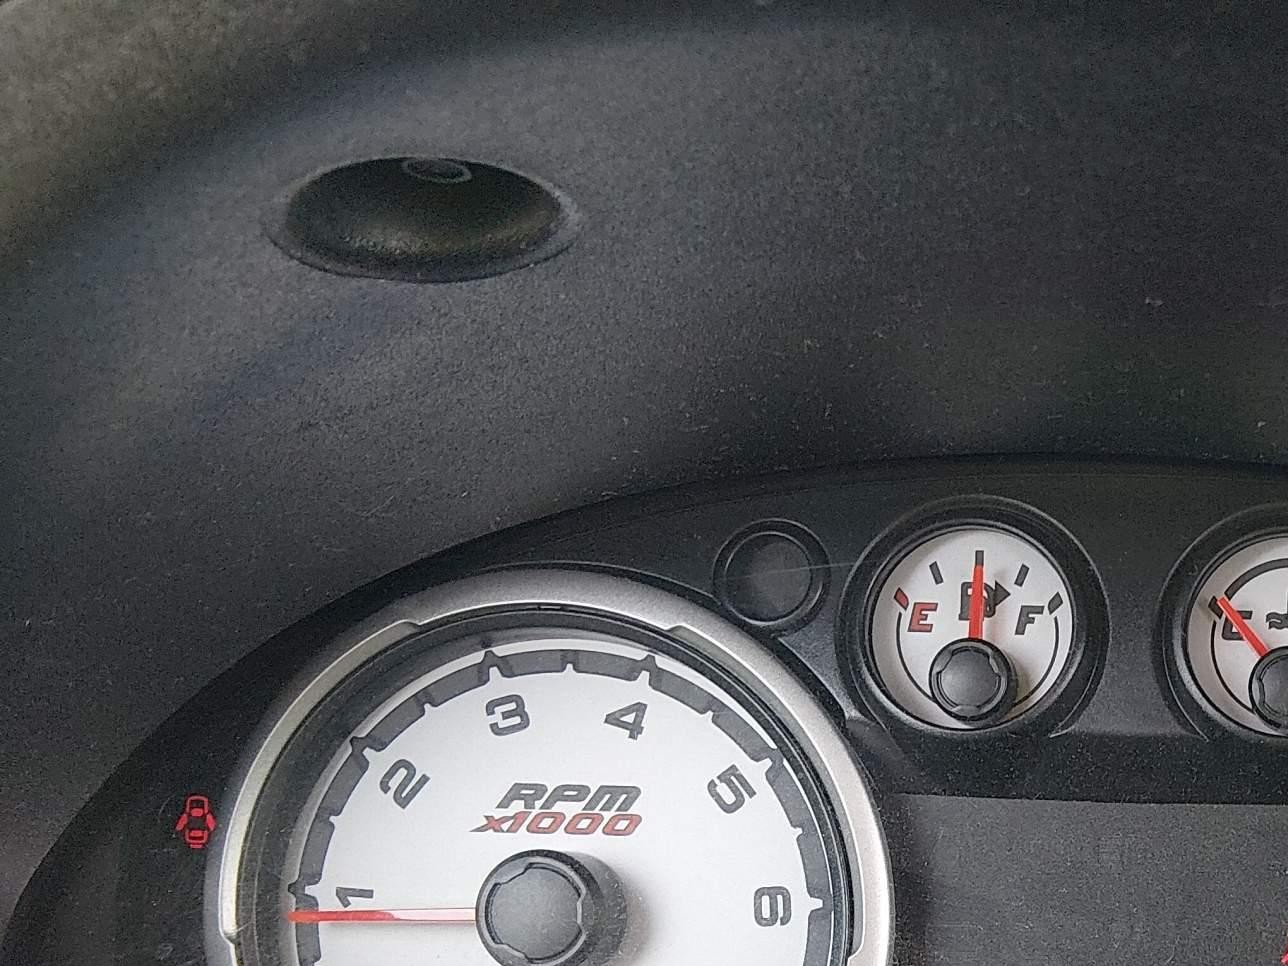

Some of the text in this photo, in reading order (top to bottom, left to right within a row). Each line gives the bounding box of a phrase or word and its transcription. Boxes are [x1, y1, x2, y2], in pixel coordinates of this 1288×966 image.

[907, 602, 939, 633] E
[1015, 605, 1045, 635] F
[485, 694, 530, 736] 3
[603, 701, 648, 740] 4
[379, 758, 429, 810] 2
[495, 783, 641, 812] RPM
[706, 763, 757, 814] 5
[469, 812, 642, 836] x1000
[334, 886, 375, 908] 1
[753, 885, 792, 928] 6
